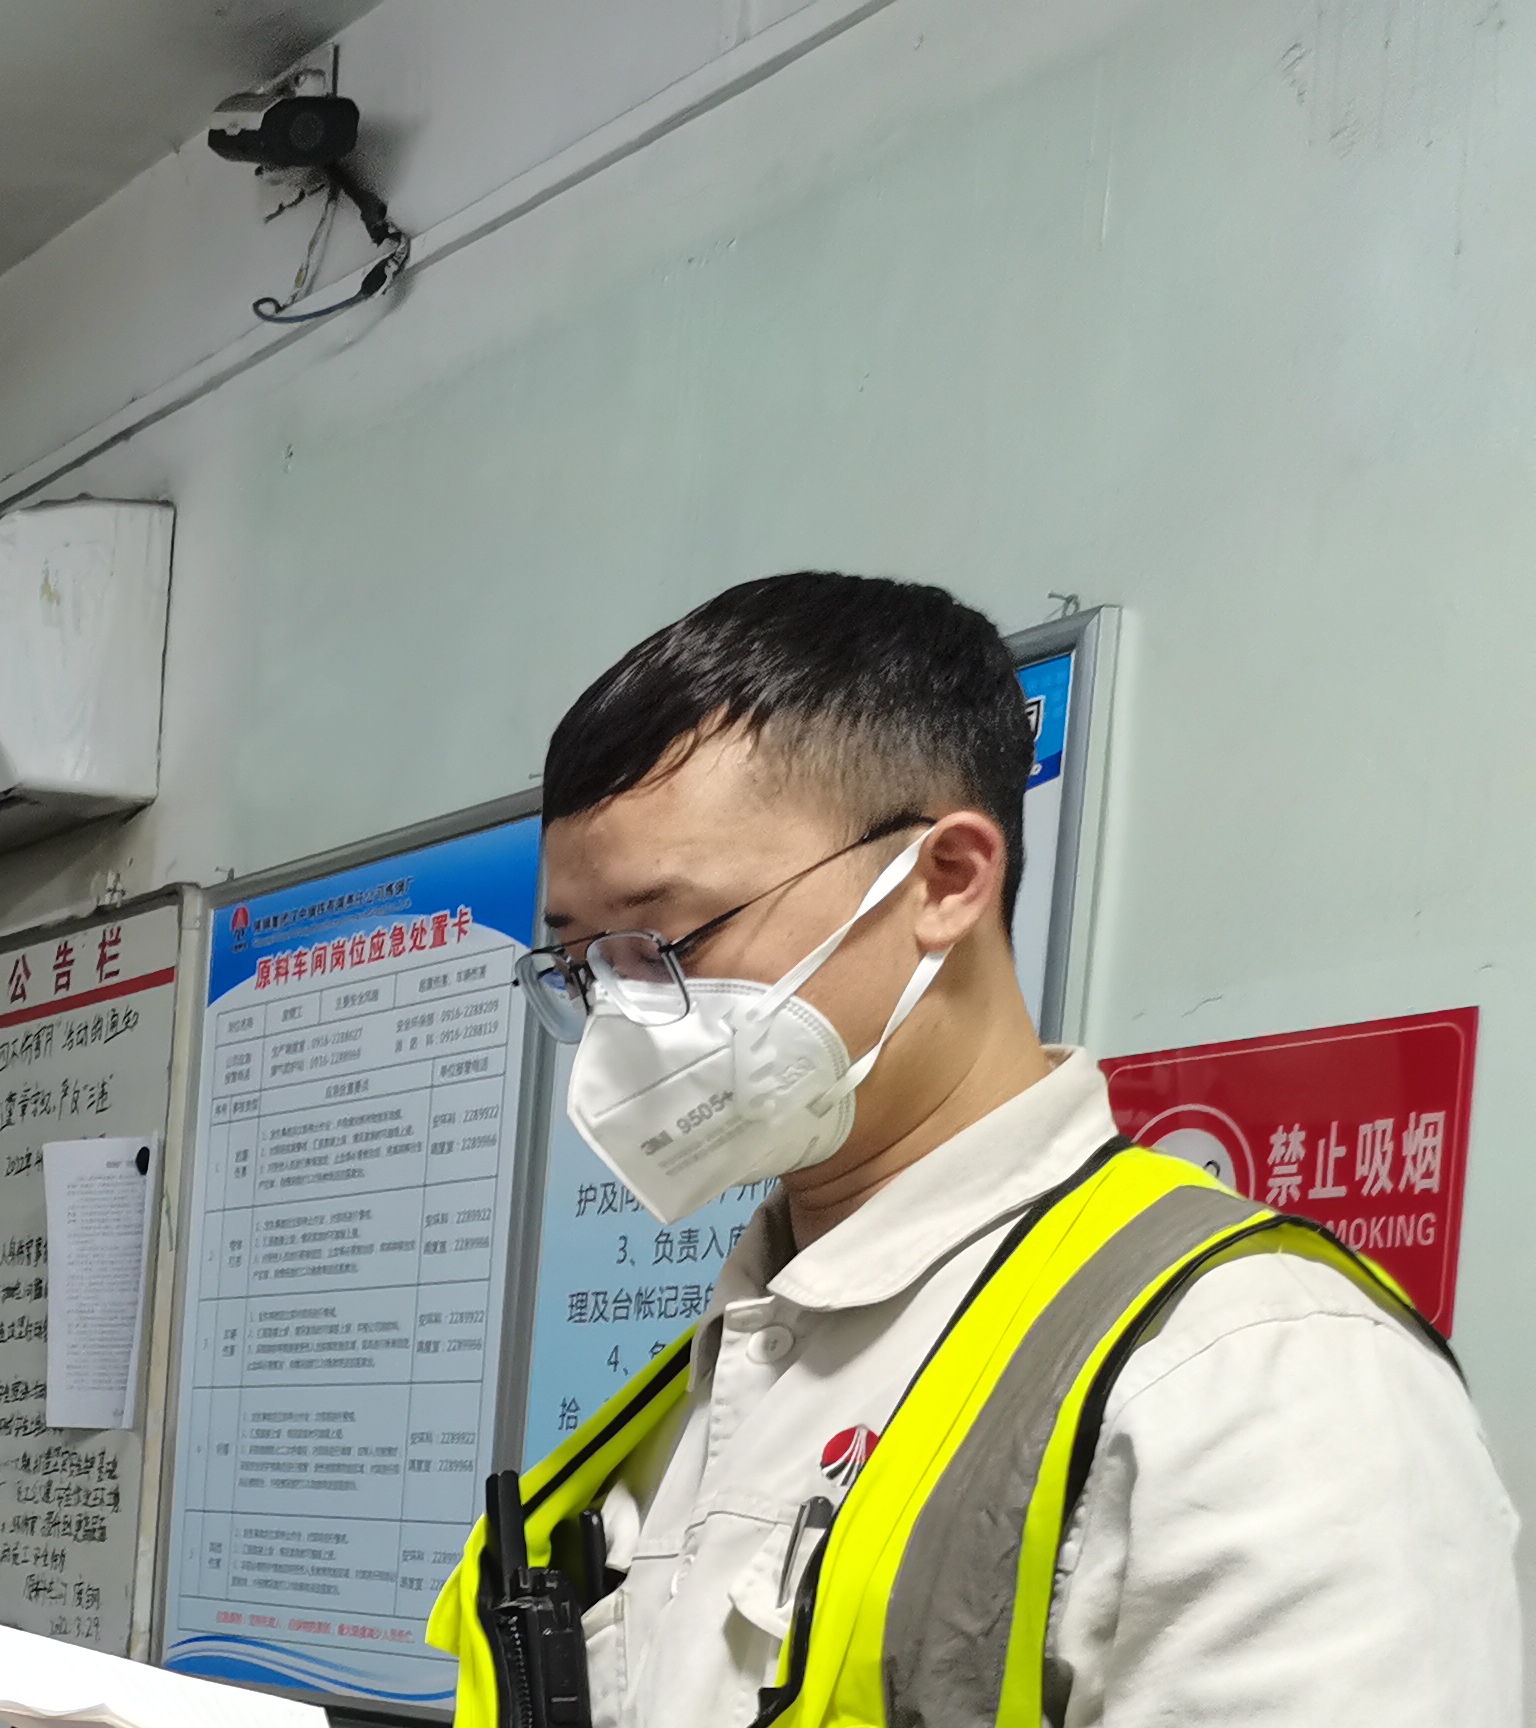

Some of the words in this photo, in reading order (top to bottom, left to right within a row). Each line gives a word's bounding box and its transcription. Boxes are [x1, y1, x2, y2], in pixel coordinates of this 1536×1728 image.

[7, 926, 123, 1003] 公告栏
[255, 905, 473, 990] 原料车间岗位应急处置卡
[640, 1129, 674, 1157] 3M
[1266, 1110, 1446, 1207] 禁止吸烟
[1323, 1212, 1436, 1250] MOKING
